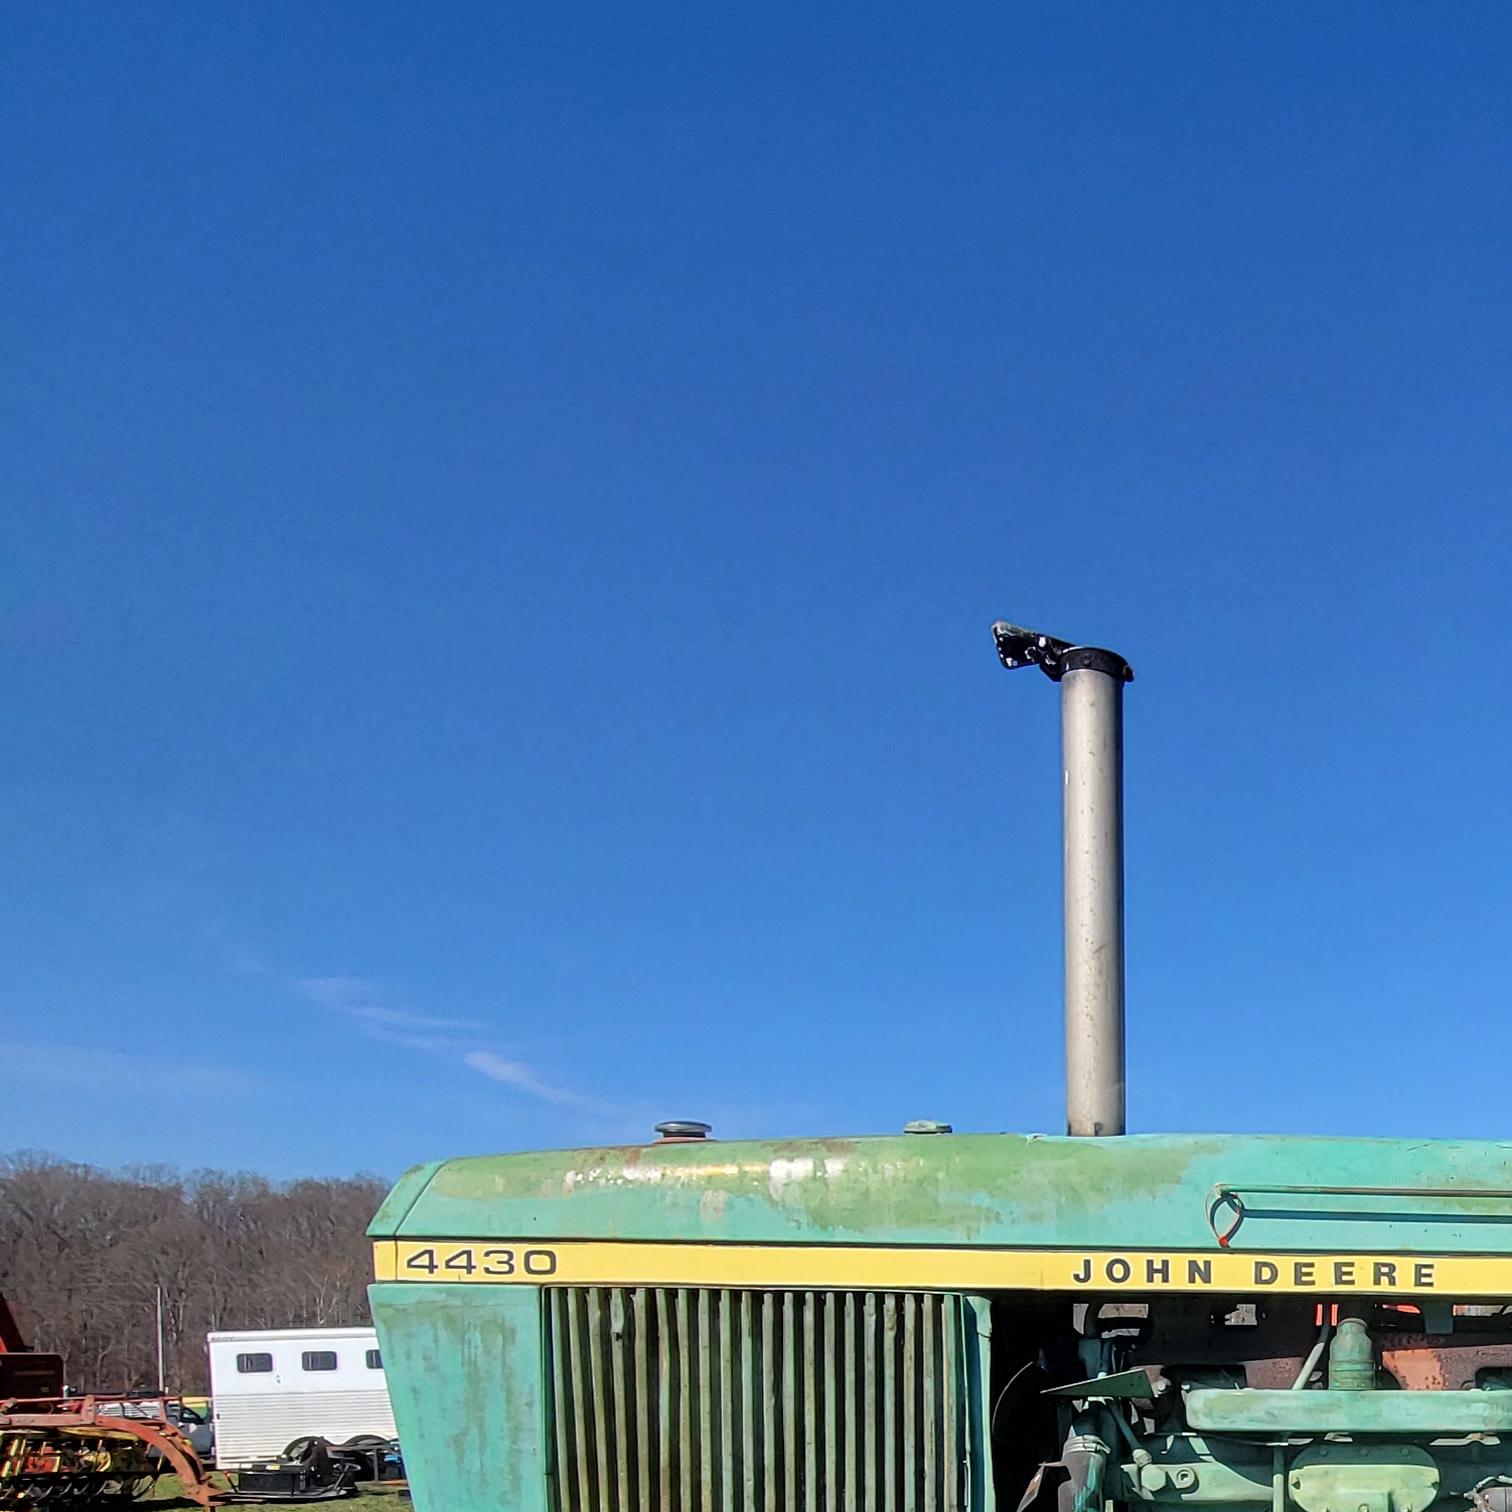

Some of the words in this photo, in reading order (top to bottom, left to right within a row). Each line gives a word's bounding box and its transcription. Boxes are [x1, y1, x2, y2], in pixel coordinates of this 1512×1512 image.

[406, 1248, 557, 1276] 4430
[1072, 1258, 1213, 1284] JOHN
[1253, 1260, 1436, 1288] DEERE
